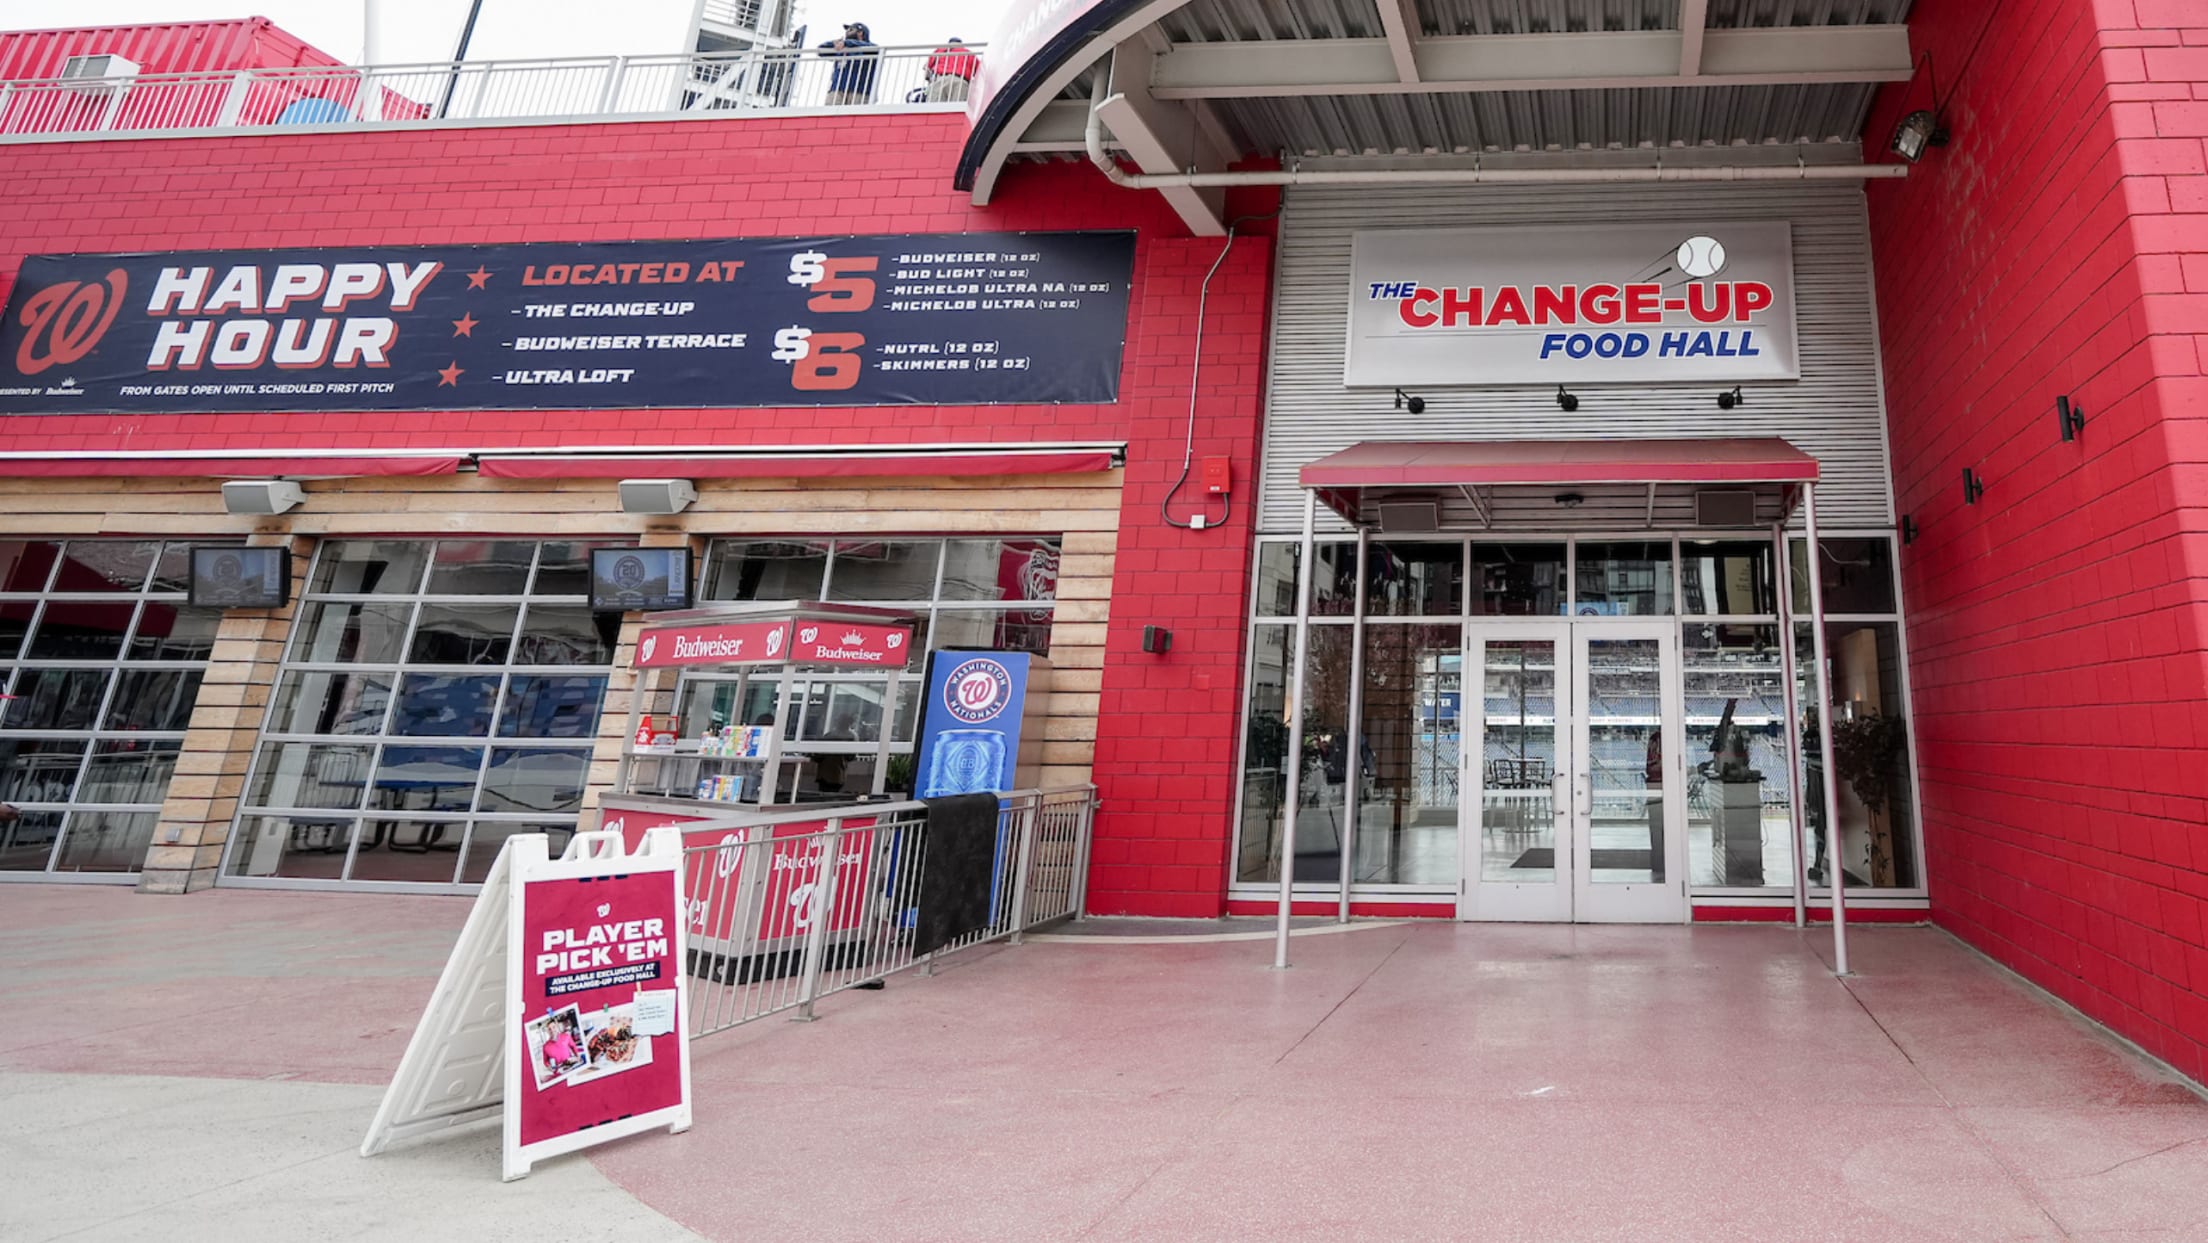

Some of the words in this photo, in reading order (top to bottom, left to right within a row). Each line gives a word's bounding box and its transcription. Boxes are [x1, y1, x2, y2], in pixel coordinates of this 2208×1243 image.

[522, 262, 690, 286] LOCATED
[696, 260, 744, 283] AT
[936, 268, 986, 279] LIGHT
[146, 260, 444, 315] HAPPY
[984, 283, 1038, 293] ULTRA
[1042, 283, 1065, 292] NA
[1368, 280, 1419, 300] THE
[570, 302, 695, 316] CHANGE-UP
[982, 299, 1035, 309] ULTRA
[1398, 281, 1774, 327] CHANGE-UP
[146, 316, 400, 371] HOUR
[645, 334, 747, 348] TERRACE
[1539, 332, 1650, 360] FOOD
[1659, 330, 1761, 358] HALL
[578, 369, 635, 383] LOFT
[120, 386, 152, 396] FROM
[153, 385, 189, 395] GATES
[191, 385, 222, 395] OPEN
[223, 384, 256, 394] UNTIL
[258, 384, 325, 394] SCHEDULED
[326, 383, 358, 393] FIRST
[360, 383, 395, 393] PITCH
[672, 635, 744, 659] Budweiser
[815, 646, 884, 661] Budweiser
[951, 662, 1007, 687] WASHINGTON
[949, 699, 1002, 719] NATIONALS
[543, 918, 664, 952] PLAYER
[536, 945, 613, 976] PICK
[618, 938, 668, 962] 'EM
[550, 986, 566, 995] THE
[566, 978, 613, 992] CHANGE-UP
[613, 973, 635, 983] FOOD
[635, 971, 656, 980] HALL
[552, 972, 596, 986] AVAILABLE
[596, 964, 644, 979] EXCLUSIVELY
[644, 963, 656, 971] AT
